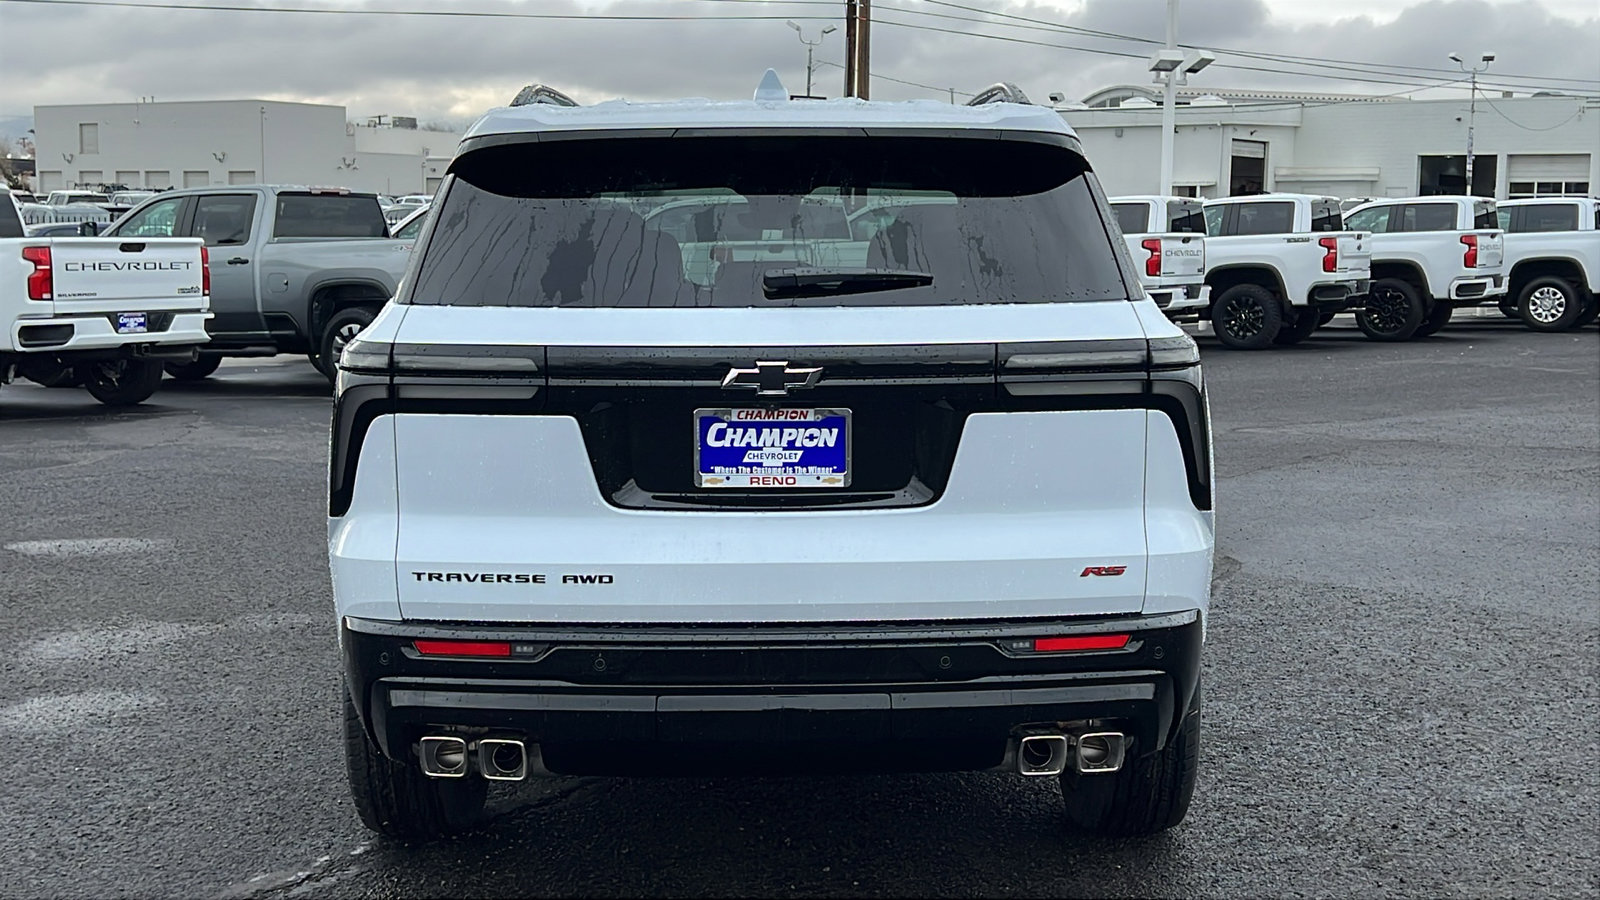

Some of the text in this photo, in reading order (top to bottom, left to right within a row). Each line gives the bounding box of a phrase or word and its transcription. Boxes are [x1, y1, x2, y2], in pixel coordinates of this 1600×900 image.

[65, 261, 193, 272] CHEVROLET
[737, 410, 809, 420] CHAMPION
[706, 422, 839, 448] CHAMPION
[747, 452, 799, 460] CHEVROLET
[738, 466, 751, 474] The
[753, 466, 784, 474] Customer
[794, 466, 807, 474] The
[749, 476, 797, 486] RENO
[1080, 566, 1127, 577] RS
[412, 572, 614, 585] TRAVERSE AWD
